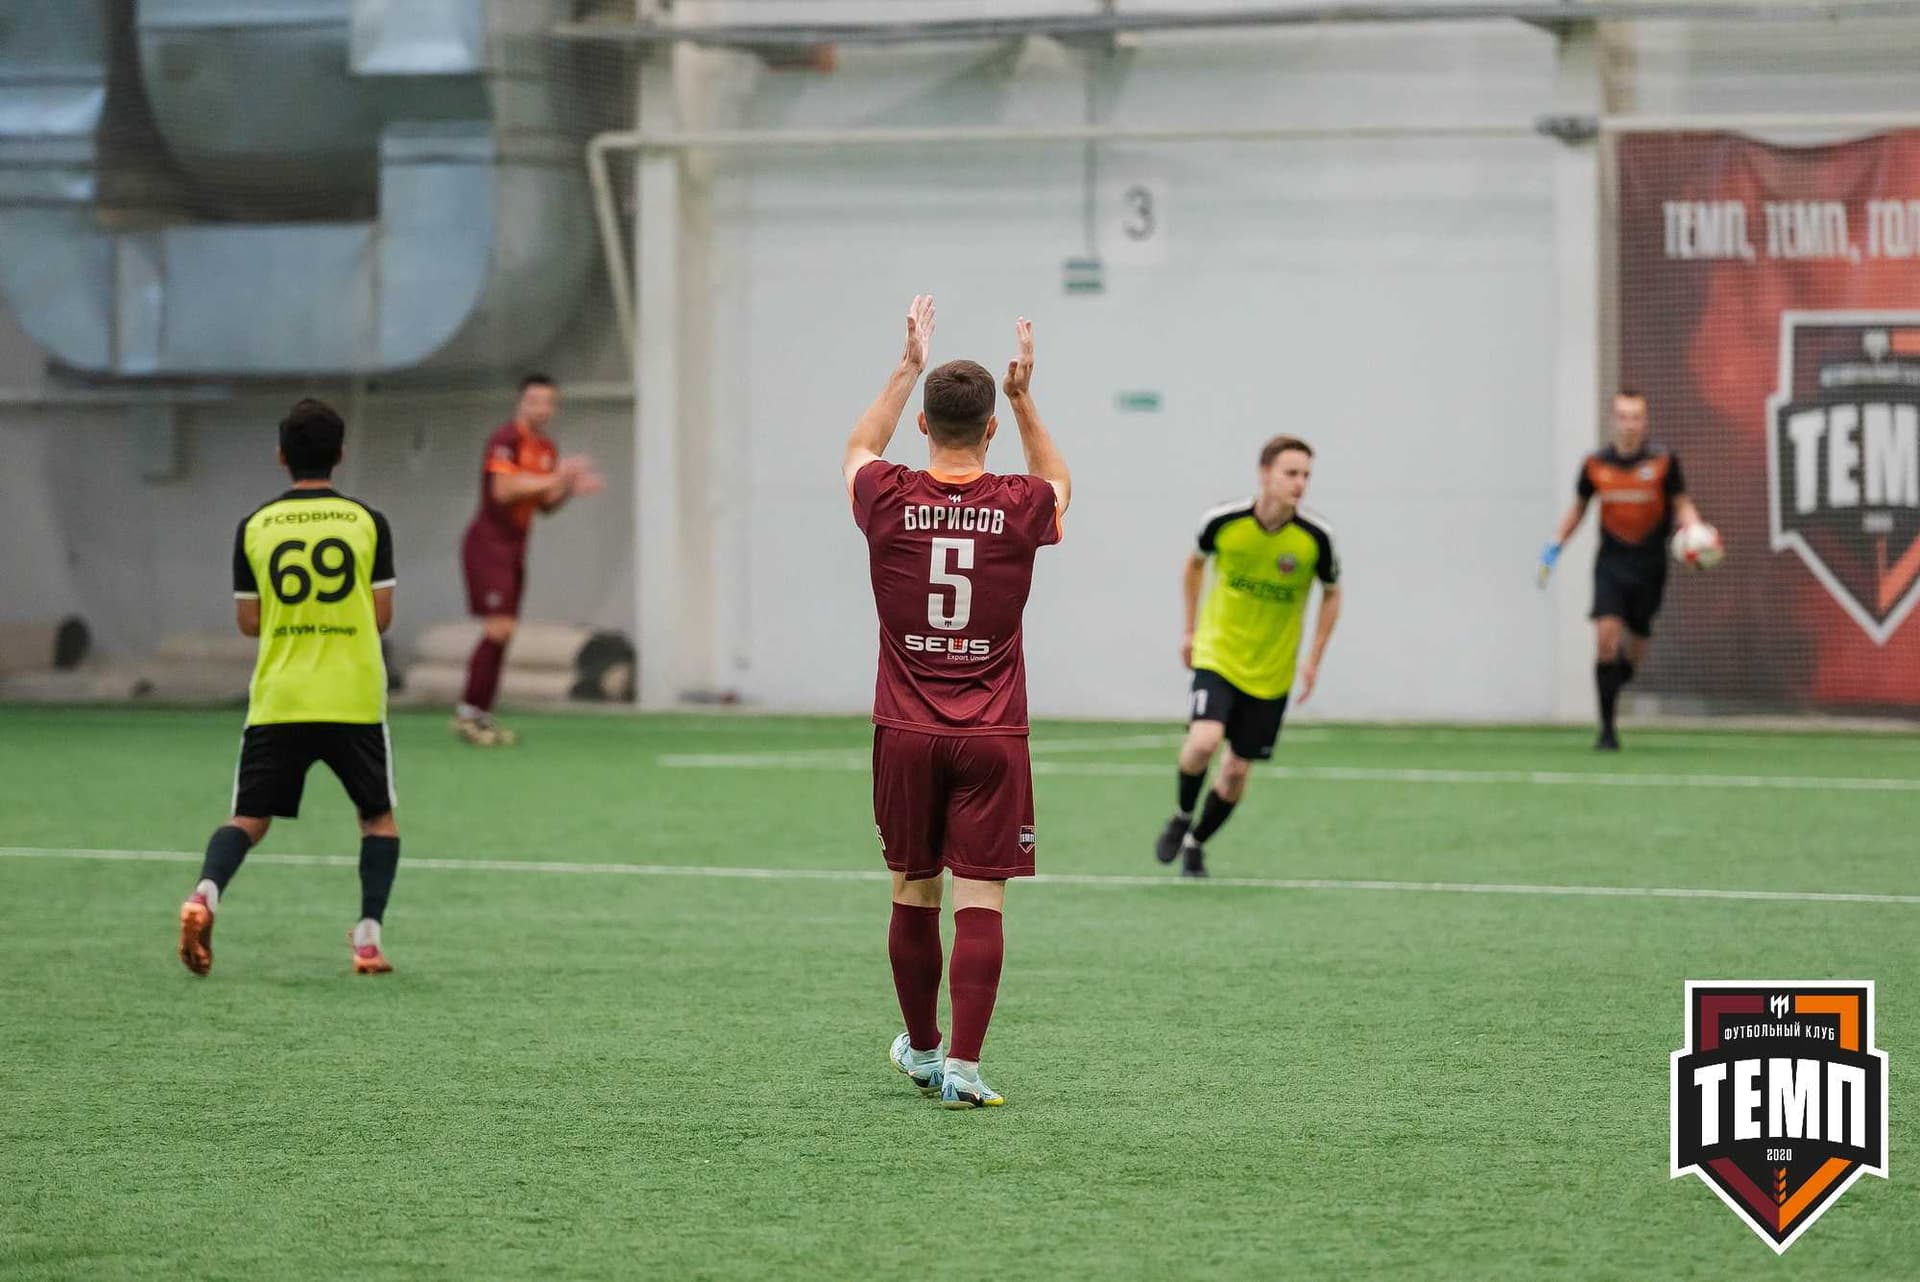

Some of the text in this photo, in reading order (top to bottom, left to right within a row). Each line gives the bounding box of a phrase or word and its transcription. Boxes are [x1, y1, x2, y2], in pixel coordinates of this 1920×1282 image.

[1123, 185, 1155, 242] 3
[904, 505, 1005, 534] БОРИСОВ
[270, 537, 356, 605] 69
[927, 537, 975, 631] 5
[904, 634, 990, 655] SEUS
